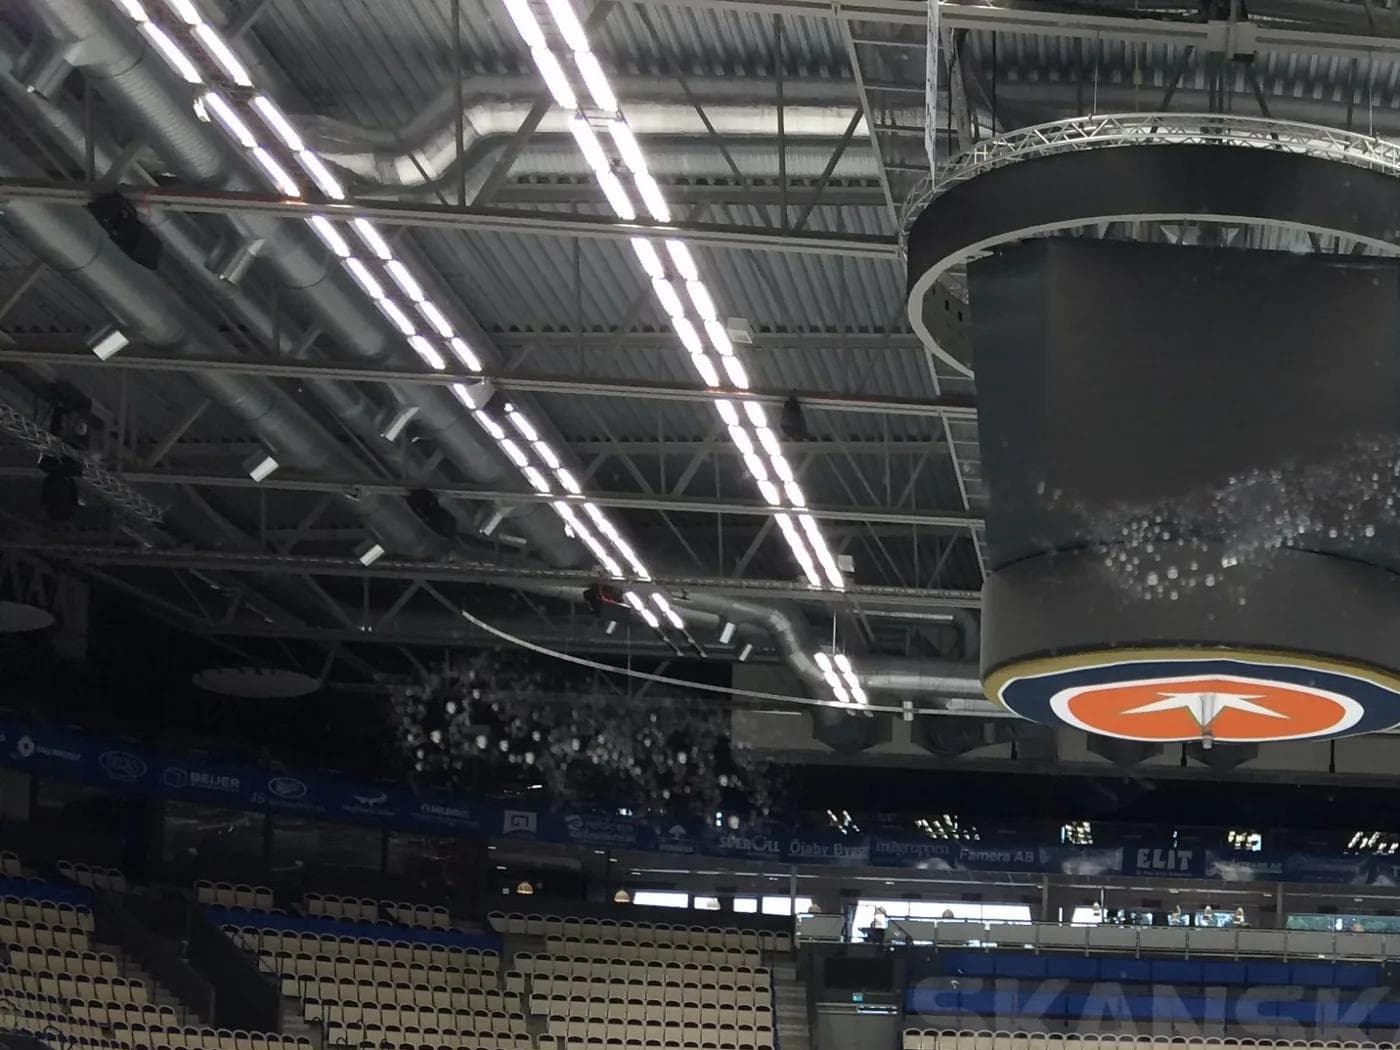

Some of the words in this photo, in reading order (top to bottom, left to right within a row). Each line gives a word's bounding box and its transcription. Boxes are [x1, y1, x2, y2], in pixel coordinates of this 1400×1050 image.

[190, 772, 240, 791] BEIJER
[1013, 850, 1035, 863] AB
[1137, 848, 1192, 870] ELIT
